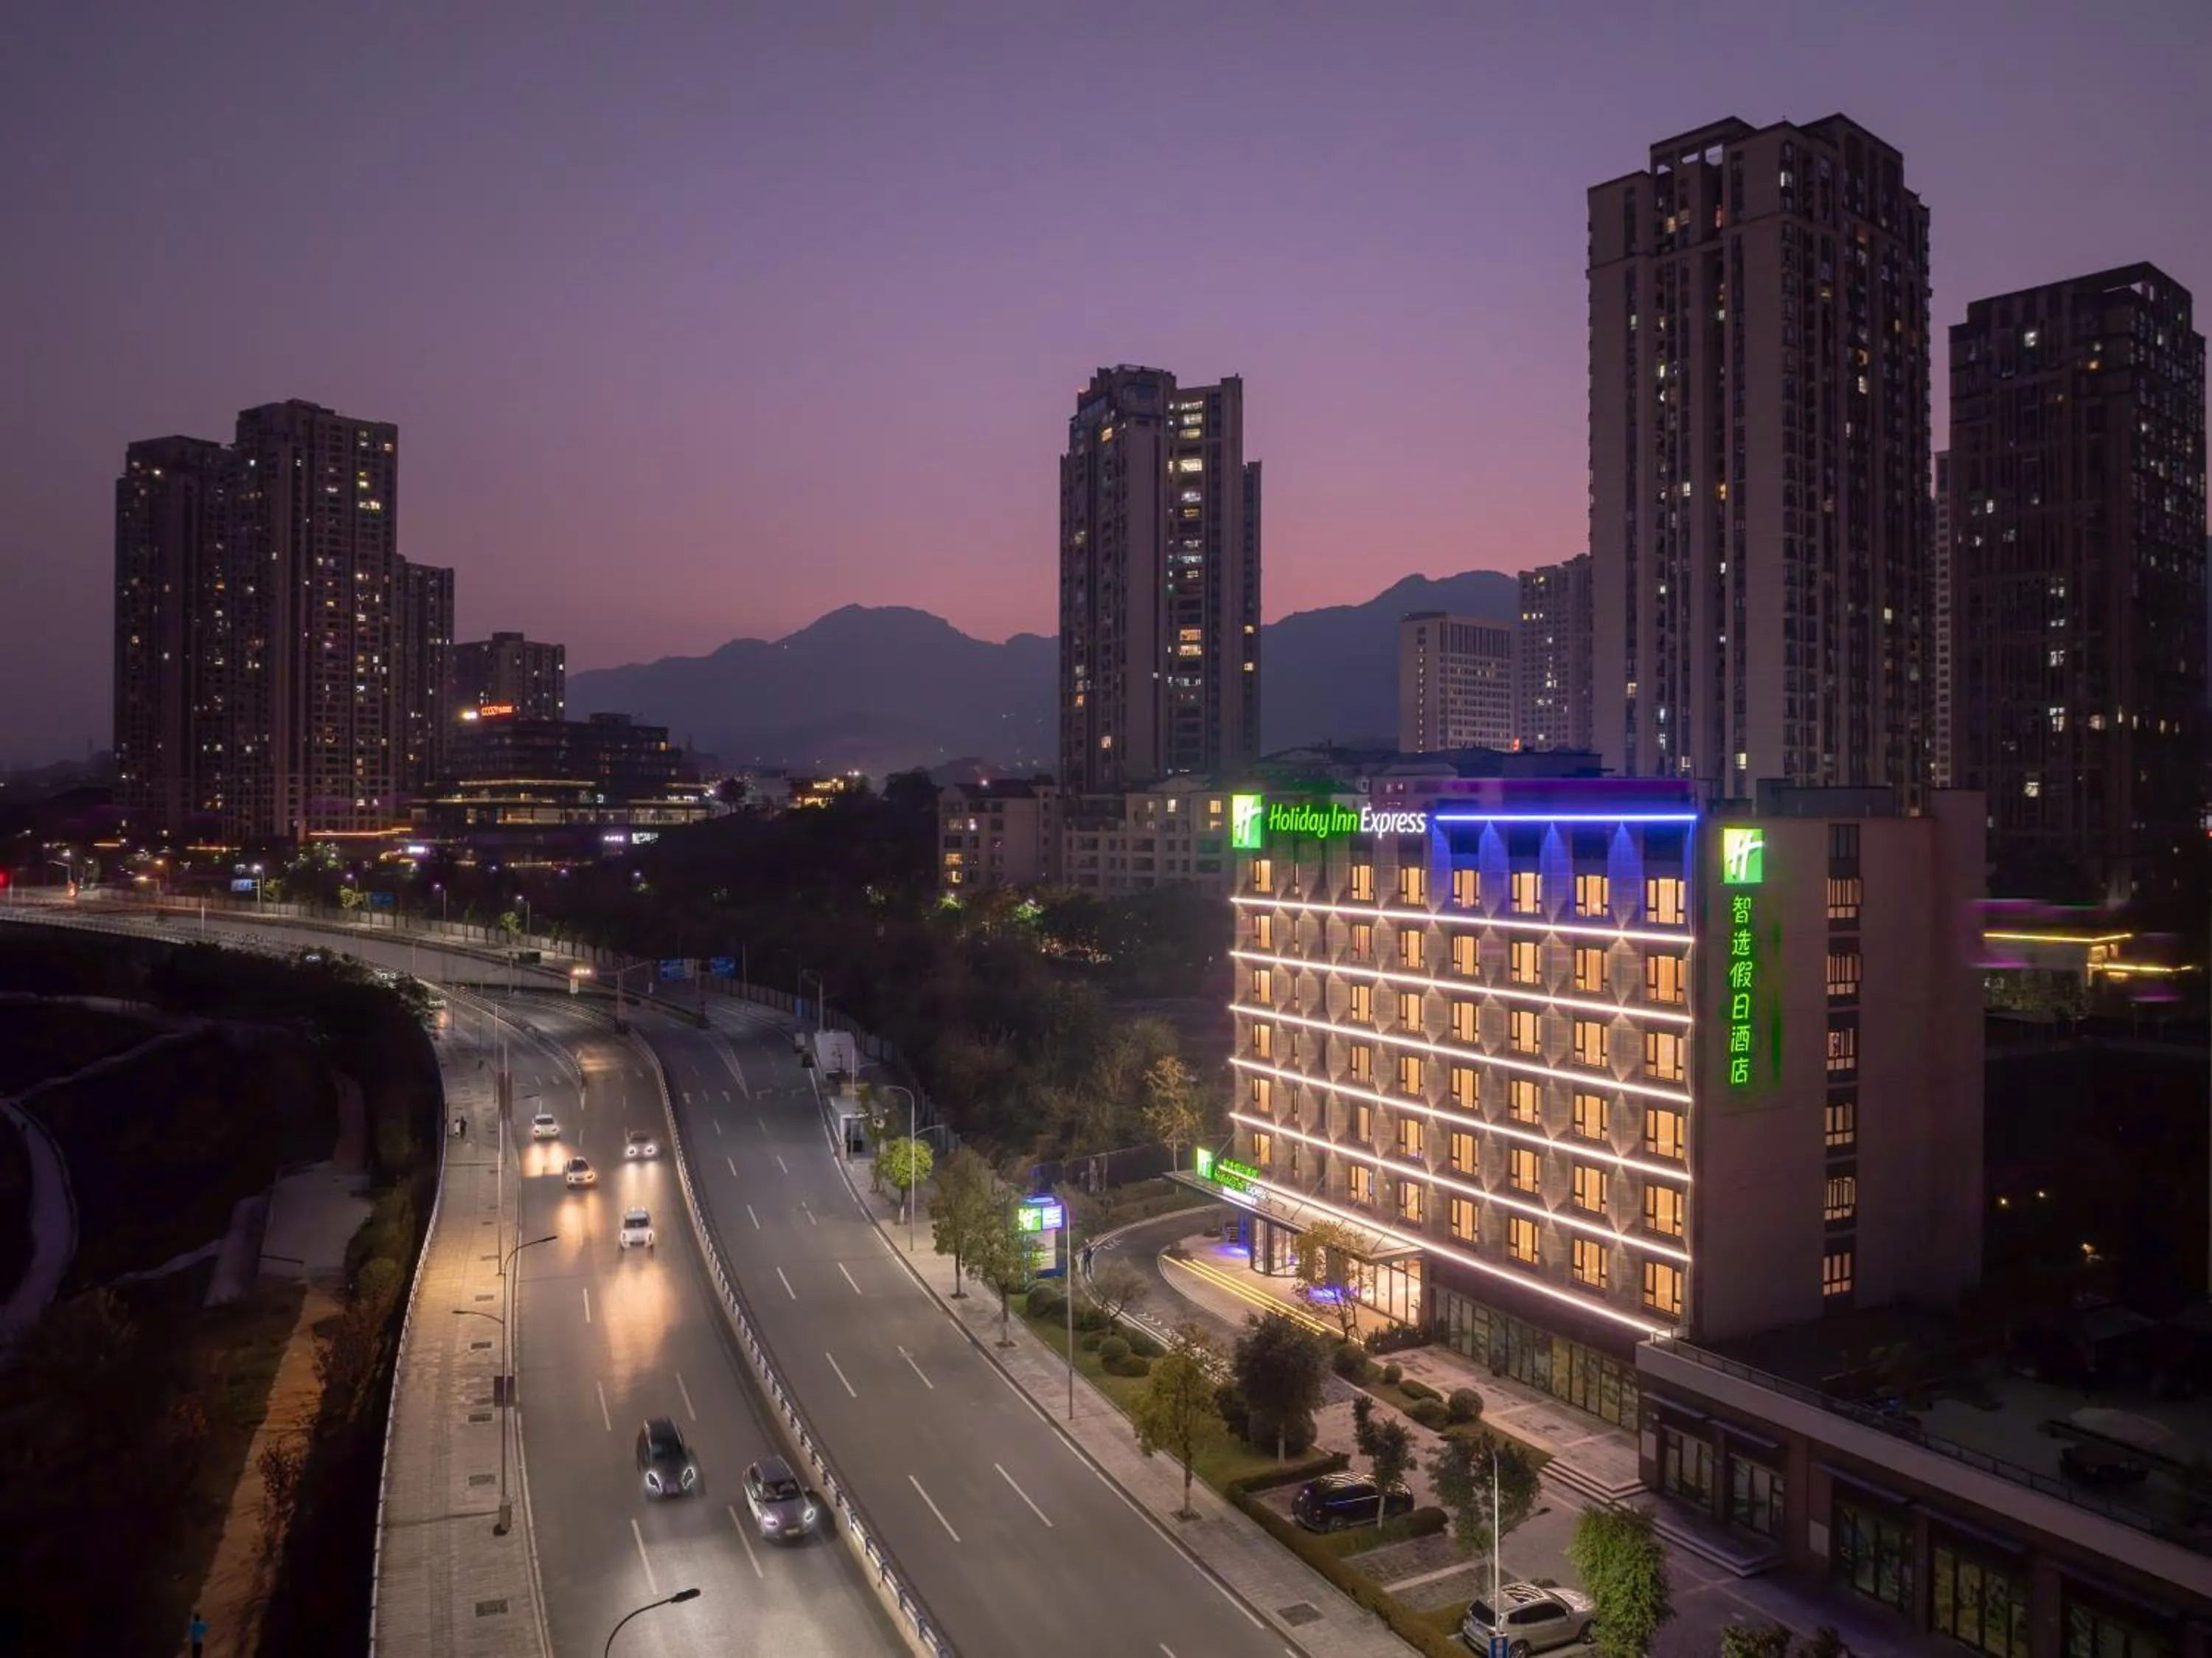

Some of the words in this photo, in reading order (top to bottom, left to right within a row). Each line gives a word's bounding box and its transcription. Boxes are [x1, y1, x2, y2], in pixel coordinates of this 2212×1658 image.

[1268, 803, 1329, 838] Holiday
[1331, 803, 1357, 831] Inn
[1360, 806, 1427, 839] Express
[1730, 895, 1753, 1085] 智选假日酒店
